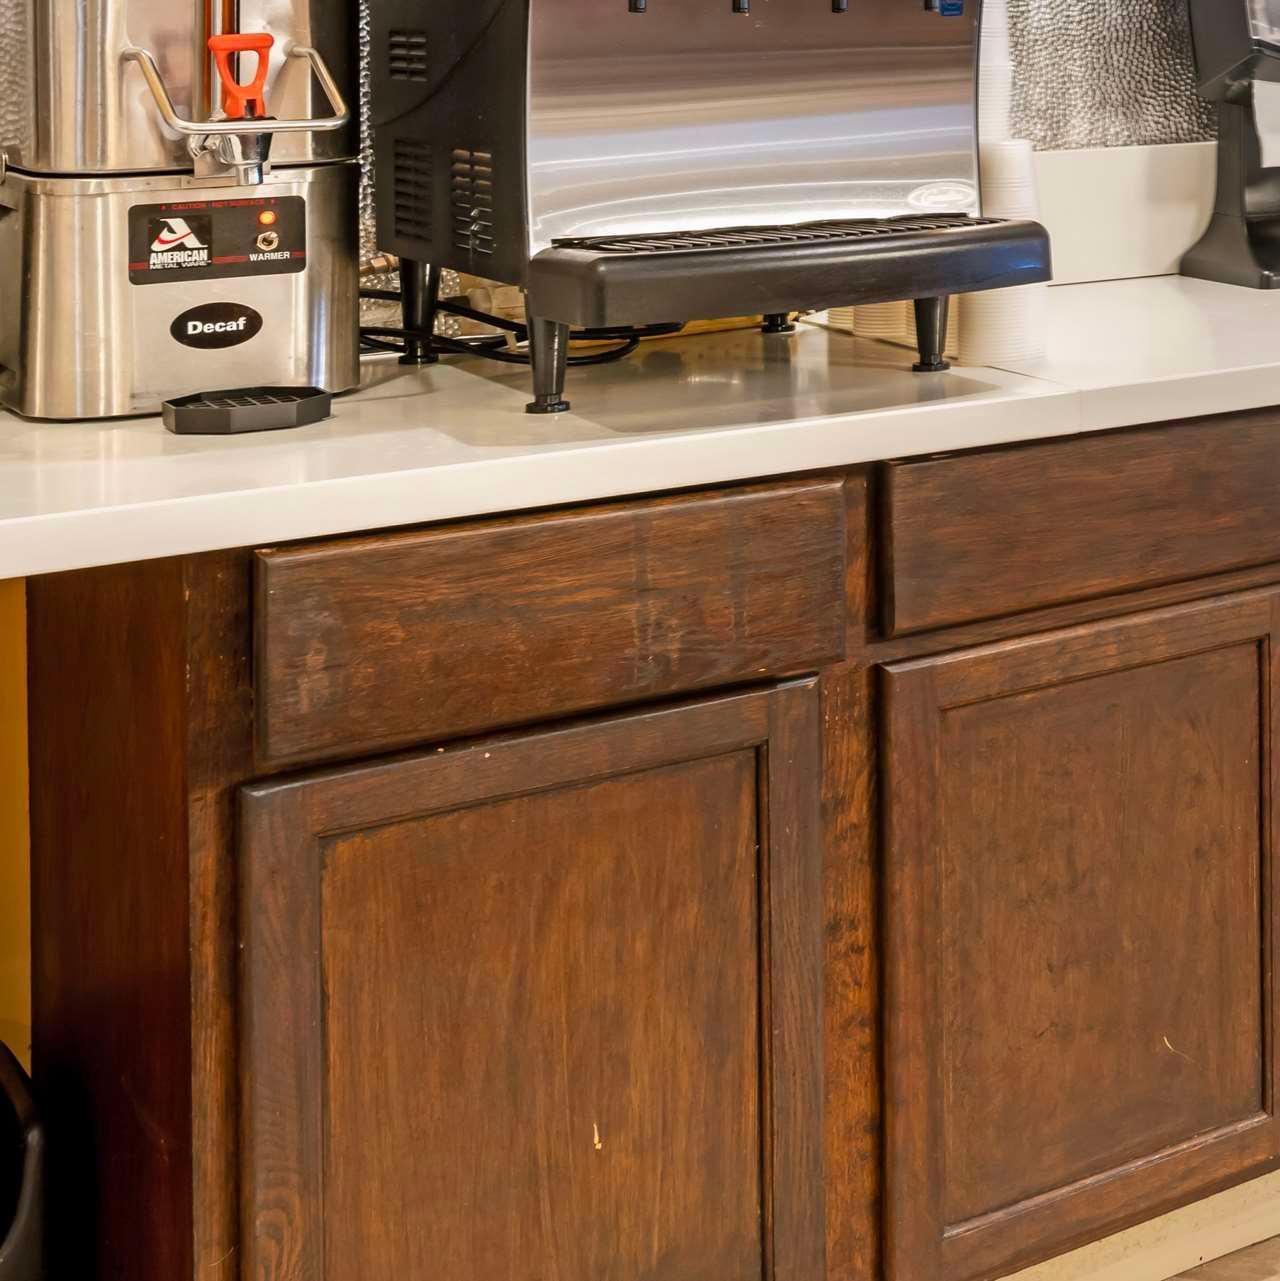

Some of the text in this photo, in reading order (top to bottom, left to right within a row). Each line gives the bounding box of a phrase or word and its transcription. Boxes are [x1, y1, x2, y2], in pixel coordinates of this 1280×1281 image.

[150, 250, 208, 265] AMERICAN
[249, 251, 290, 262] WARMER
[187, 317, 247, 335] Decaf
